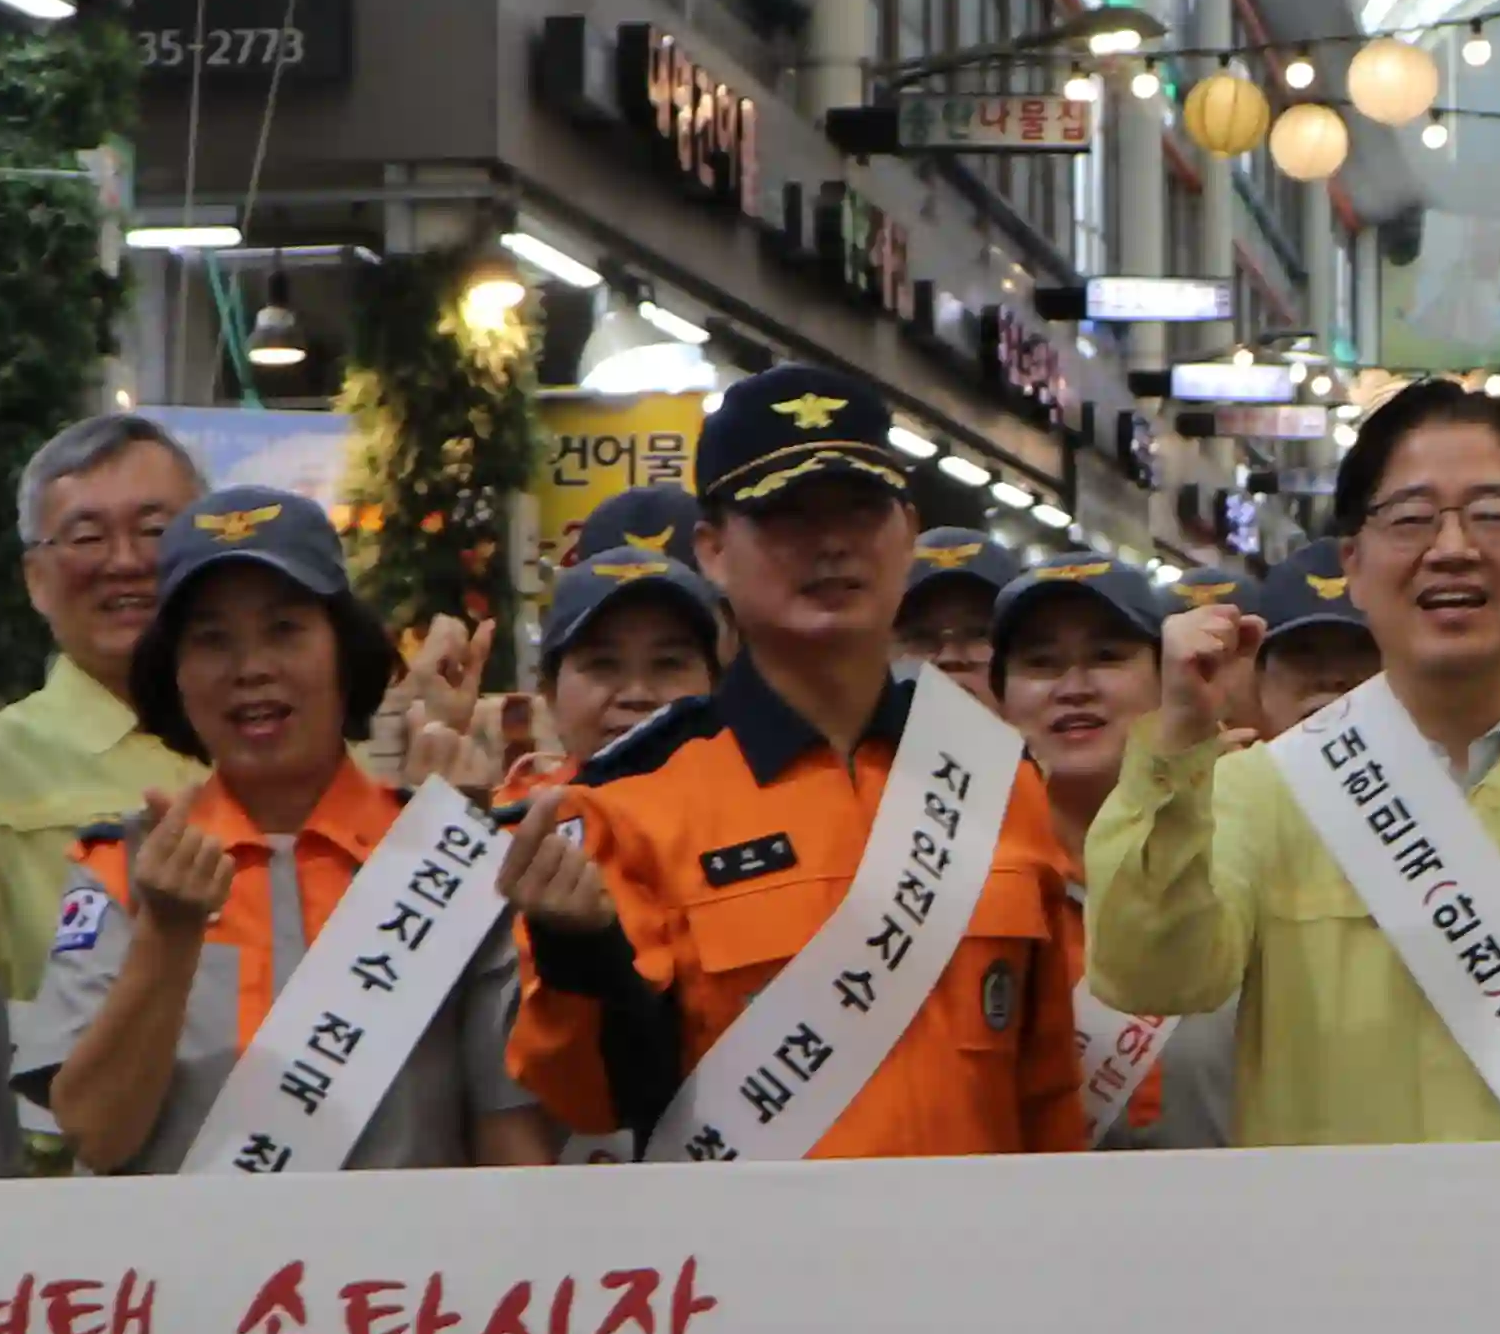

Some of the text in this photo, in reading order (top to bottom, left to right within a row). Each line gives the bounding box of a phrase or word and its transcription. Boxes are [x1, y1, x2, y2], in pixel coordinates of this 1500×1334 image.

[549, 433, 688, 488] 건어물
[832, 752, 971, 1015] 지역안전지수
[279, 1011, 364, 1116] 전국
[740, 1022, 834, 1125] 전국
